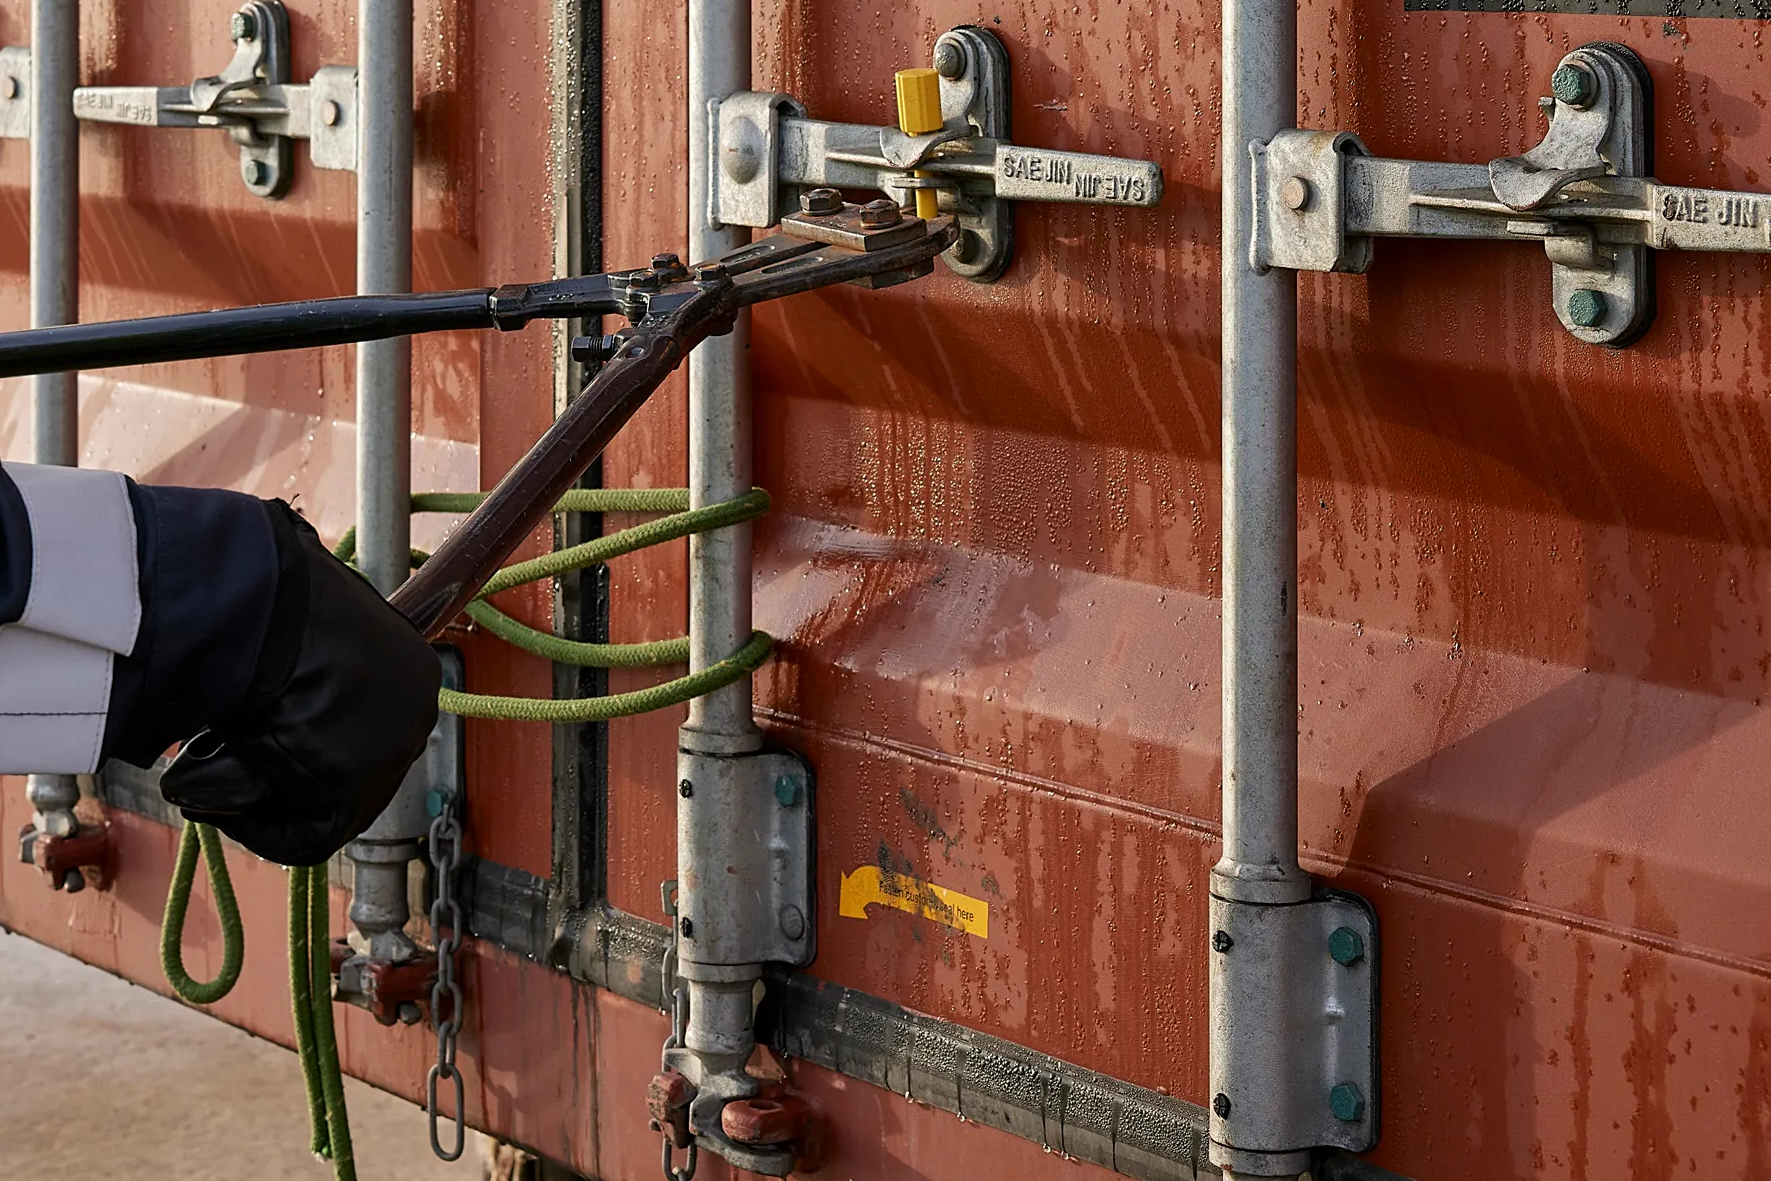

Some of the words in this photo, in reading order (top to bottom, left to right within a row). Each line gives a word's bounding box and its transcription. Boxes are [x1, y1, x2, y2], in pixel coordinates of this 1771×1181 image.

[1003, 154, 1042, 181] SAE
[1044, 159, 1071, 185] JIN
[1105, 175, 1145, 201] SAE
[1663, 193, 1707, 223] SAE
[1716, 198, 1758, 228] JIN
[957, 906, 974, 922] here
